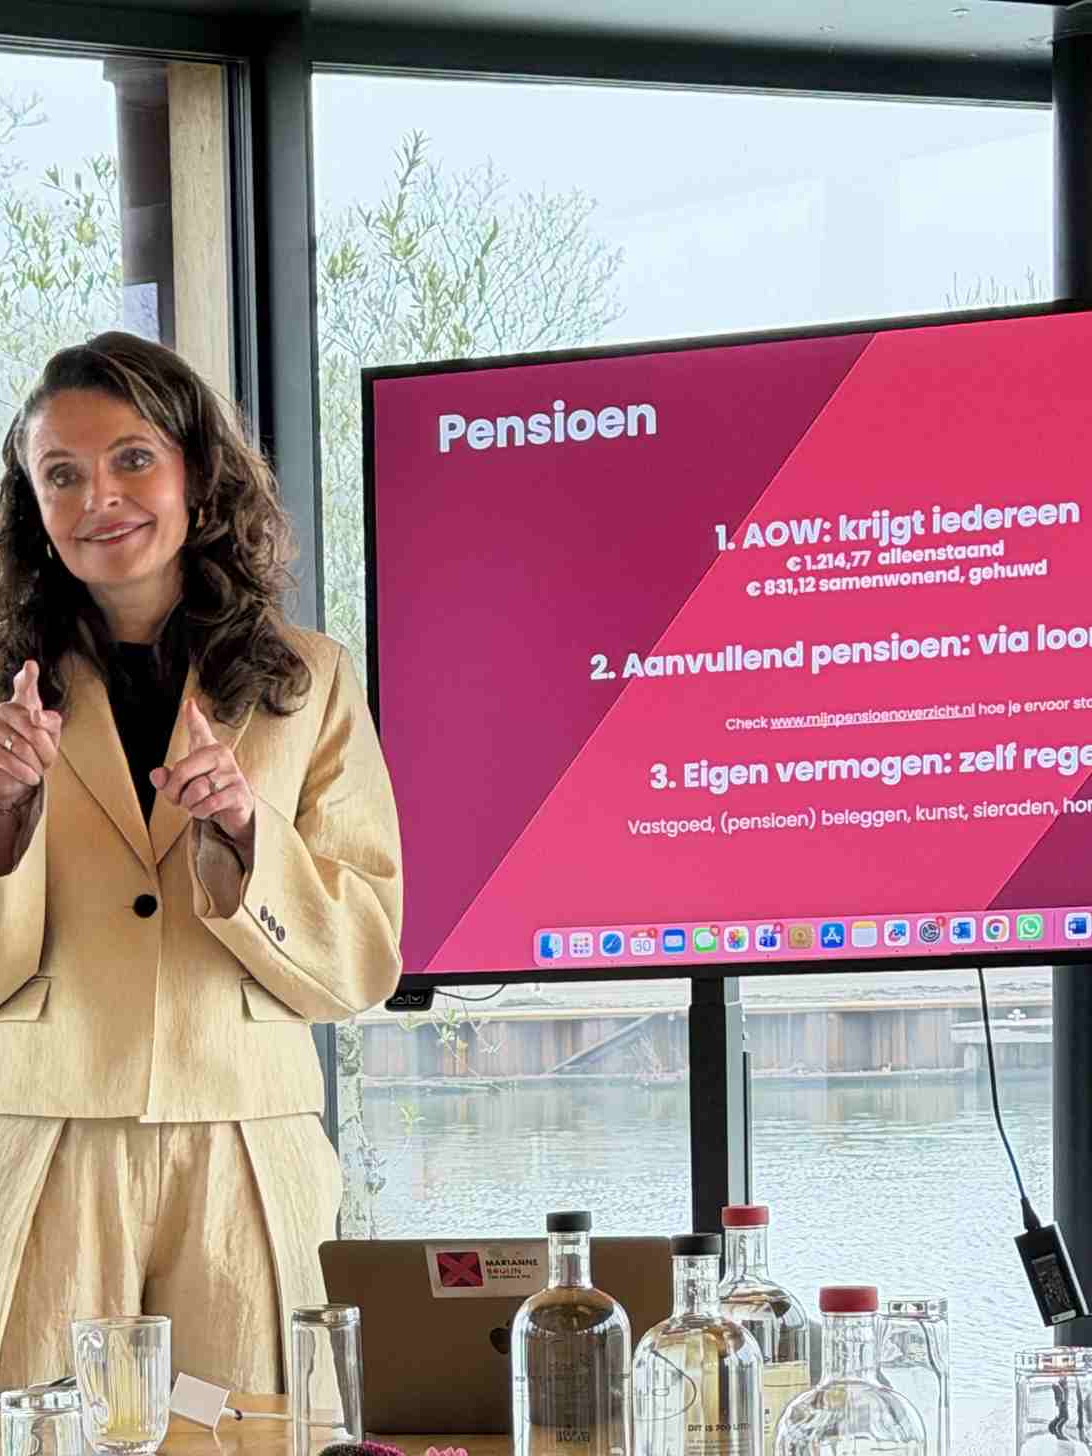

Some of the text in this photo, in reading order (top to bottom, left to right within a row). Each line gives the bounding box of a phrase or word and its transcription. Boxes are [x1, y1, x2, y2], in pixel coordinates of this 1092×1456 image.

[439, 399, 657, 452] Pensioen
[715, 501, 1081, 550] 1. AOW: krijgt iedereen
[764, 576, 816, 597] 831,12
[819, 565, 966, 593] samenwonend,
[968, 559, 1048, 586] gehuwd
[804, 550, 872, 572] 1.214,77
[877, 540, 1005, 566] alleenstaand
[590, 654, 616, 680] 2.
[622, 641, 804, 679] Aanvullend
[812, 632, 971, 674] pensioen:
[978, 625, 1029, 654] via
[725, 716, 768, 731] Check
[770, 703, 976, 731] www.mijnpensioenoverzicht.nl
[978, 702, 1004, 716] hoe
[1007, 700, 1021, 718] je
[1024, 699, 1069, 713] ervoor
[649, 763, 676, 790] 3.
[684, 760, 768, 795] Eigen
[775, 752, 952, 788] vermogen:
[958, 742, 1018, 773] zelf
[627, 816, 716, 838] Vastgoed,
[719, 810, 817, 835] (pensioen)
[821, 805, 911, 830] beleggen,
[914, 803, 968, 823] kunst,
[972, 798, 1061, 819] sieraden,
